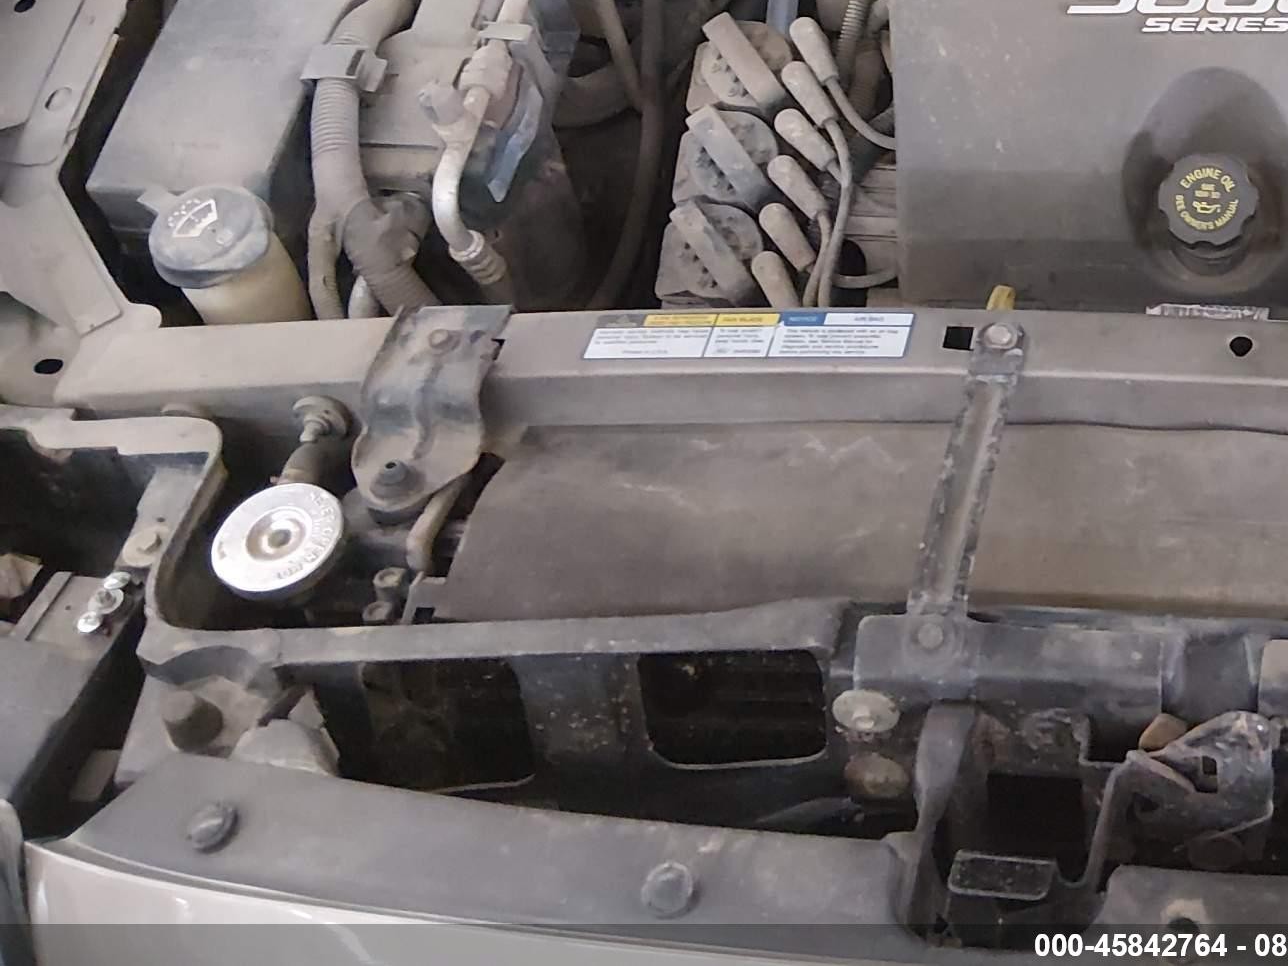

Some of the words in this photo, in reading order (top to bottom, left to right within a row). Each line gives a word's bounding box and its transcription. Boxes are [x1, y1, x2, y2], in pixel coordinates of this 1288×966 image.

[1179, 167, 1222, 189] ENGINE
[1220, 174, 1236, 193] OIL
[1213, 199, 1239, 228] MANUAL
